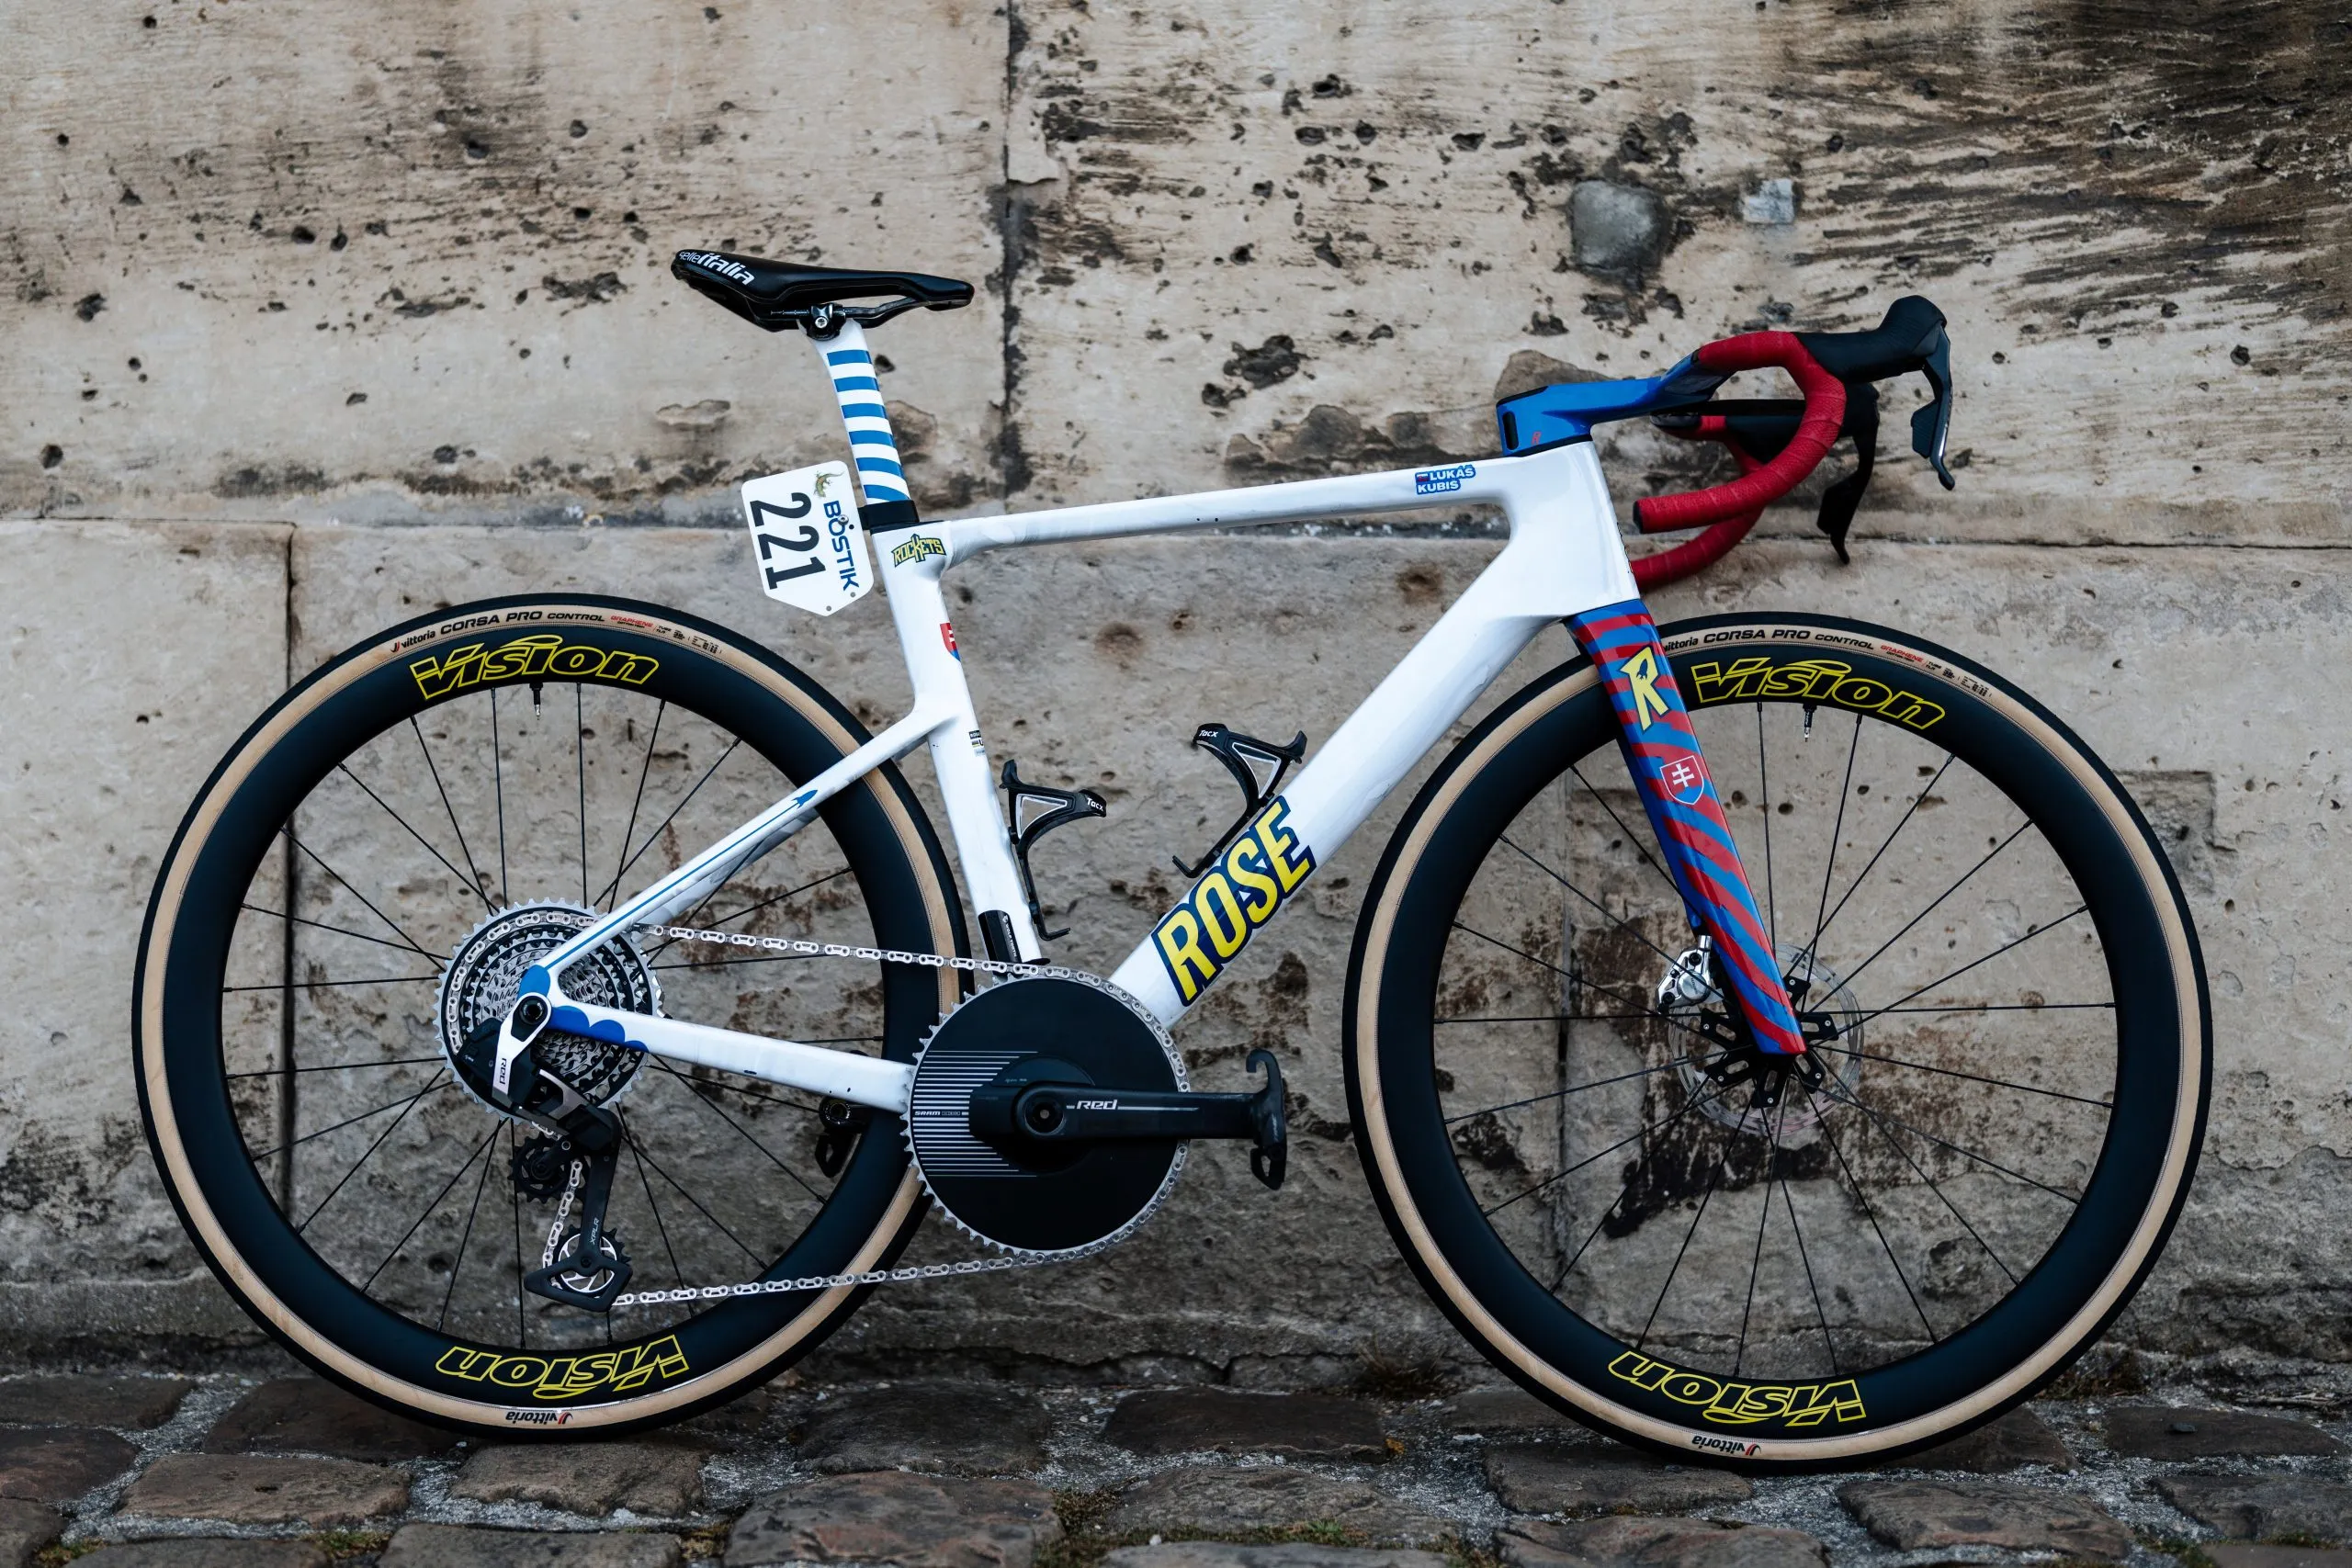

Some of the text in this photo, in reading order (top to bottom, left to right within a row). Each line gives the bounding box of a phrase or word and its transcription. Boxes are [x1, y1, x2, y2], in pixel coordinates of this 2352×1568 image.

[749, 491, 827, 591] 221
[822, 500, 860, 592] BOSTIK
[892, 534, 946, 568] ROCKETS
[401, 629, 436, 649] vittoria
[440, 615, 500, 635] CORSA
[505, 611, 543, 623] PRO
[547, 613, 605, 623] CONTROL
[610, 615, 654, 627] GRAPHENE
[1703, 629, 1766, 644] CORSA
[1771, 629, 1811, 640] PRO
[1815, 634, 1874, 650] CONTROL
[1880, 645, 1924, 663] GRAPHENE
[1619, 645, 1670, 732] R
[1087, 797, 1103, 812] Tacx
[1154, 798, 1314, 1005] ROSE
[590, 1217, 600, 1246] XPLR
[504, 1410, 559, 1425] vittoria
[1691, 1435, 1747, 1455] vittoria
